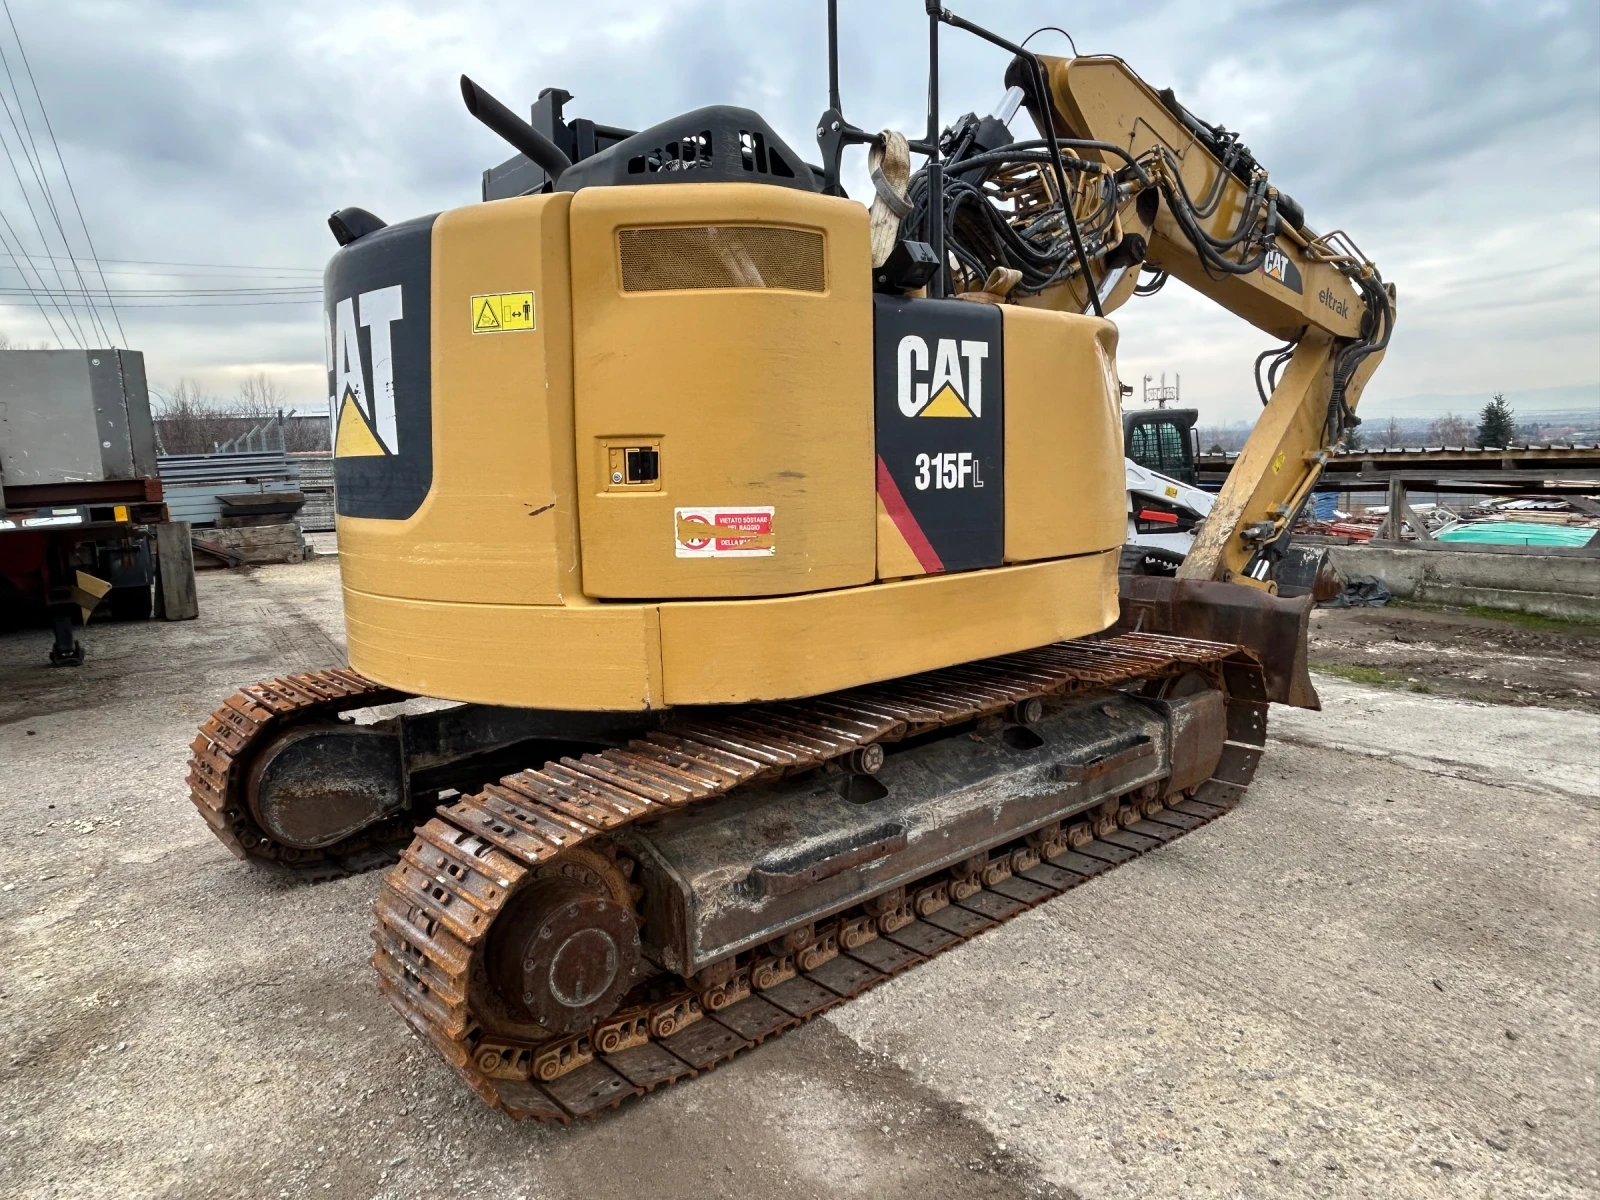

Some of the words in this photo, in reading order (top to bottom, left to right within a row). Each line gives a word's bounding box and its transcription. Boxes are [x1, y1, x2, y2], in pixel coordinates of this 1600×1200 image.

[1264, 251, 1288, 282] CAT
[1318, 287, 1348, 319] eltrak
[897, 335, 989, 418] CAT
